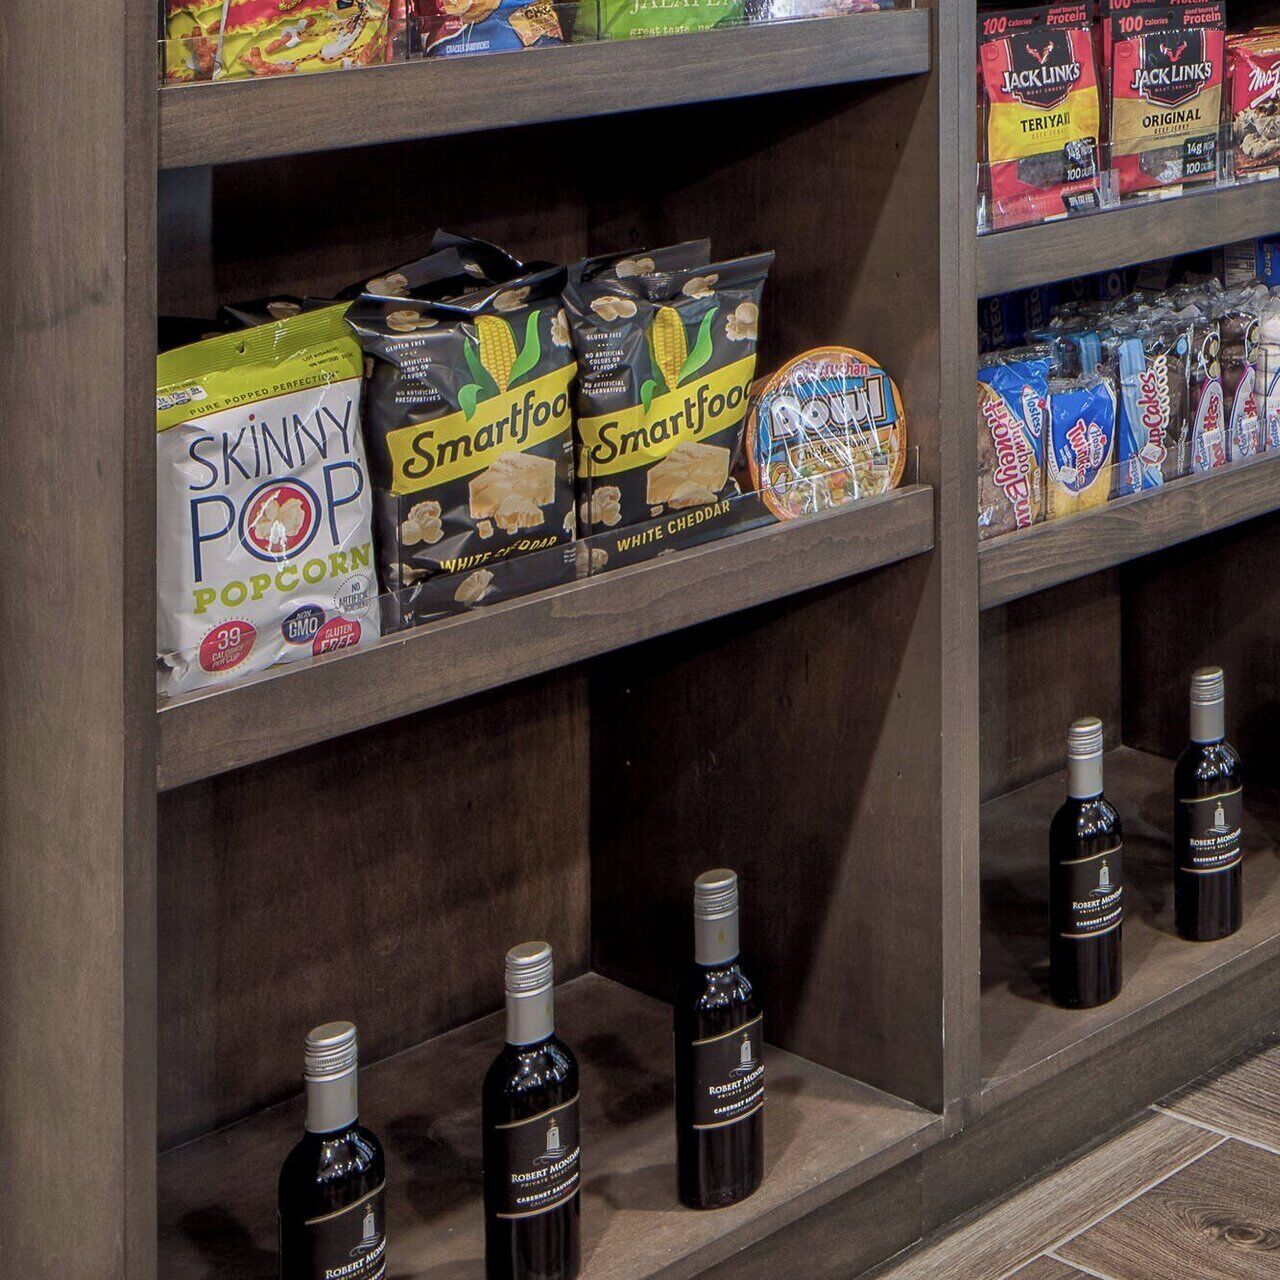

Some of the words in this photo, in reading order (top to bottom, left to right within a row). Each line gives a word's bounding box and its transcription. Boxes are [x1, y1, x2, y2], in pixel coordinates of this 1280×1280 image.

[983, 17, 1007, 35] 100
[1046, 10, 1087, 25] Protein
[1118, 15, 1143, 33] 100
[1183, 12, 1221, 25] Protein
[1001, 70, 1040, 93] JACK
[1041, 63, 1081, 85] LINK'S
[1131, 69, 1170, 90] JACK
[1171, 62, 1212, 83] LINK'S
[1142, 108, 1202, 129] ORIGINAL
[189, 404, 221, 417] PURE
[227, 387, 271, 407] POPPED
[273, 372, 336, 394] PERFECTION
[189, 400, 354, 491] SKINNY
[190, 461, 364, 583] POP
[616, 525, 663, 553] WHITE
[668, 499, 731, 535] CHEDDAR
[440, 549, 492, 572] WHITE
[193, 543, 372, 615] POPCORN
[216, 626, 241, 647] 39
[287, 616, 319, 638] GMO
[324, 623, 353, 640] GLUTEN
[1190, 837, 1216, 848] ROBERT
[1072, 898, 1101, 911] ROBERT
[708, 1080, 743, 1096] ROBERT
[713, 1099, 746, 1115] CABERNET
[511, 1168, 549, 1184] ROBERT
[516, 1190, 552, 1204] CABERNET
[326, 1257, 365, 1280] ROBERT
